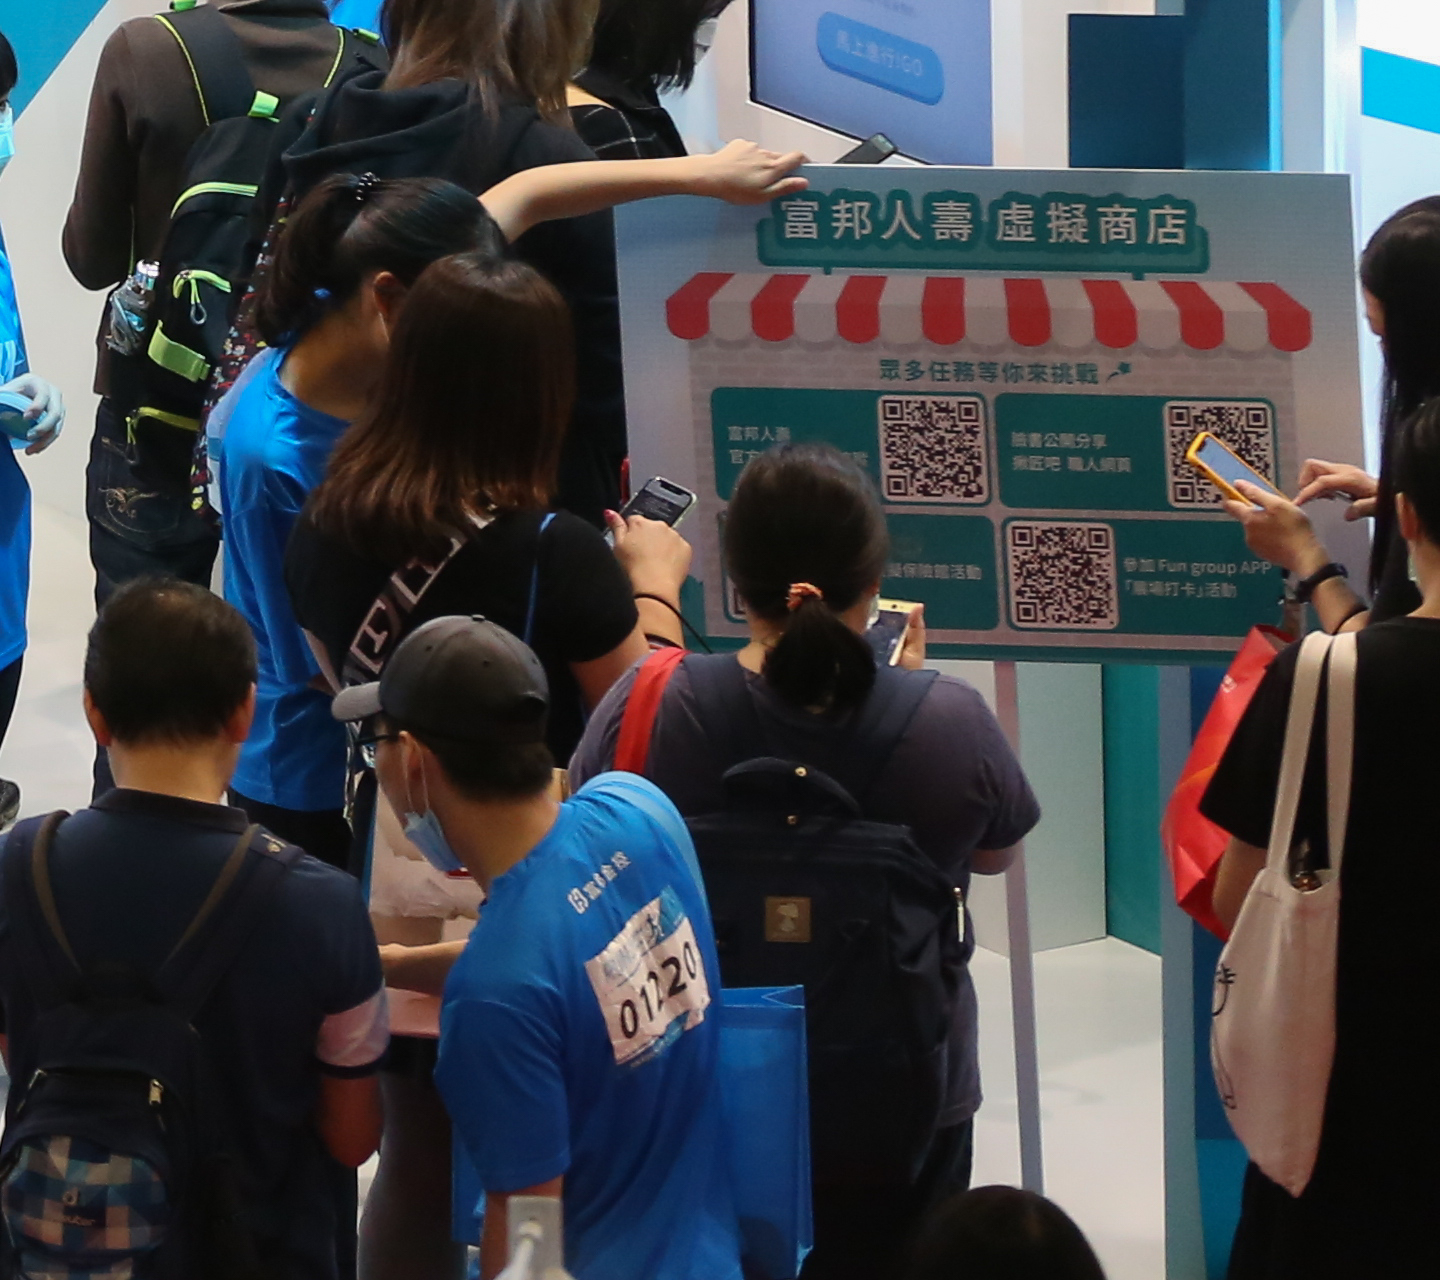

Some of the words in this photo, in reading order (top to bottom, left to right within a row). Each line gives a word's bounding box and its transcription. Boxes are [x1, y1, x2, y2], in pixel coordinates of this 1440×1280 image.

[781, 199, 975, 243] 富邦人壽
[996, 203, 1189, 247] 虛擬商店
[880, 359, 1100, 386] 眾多任務等你來挑戰
